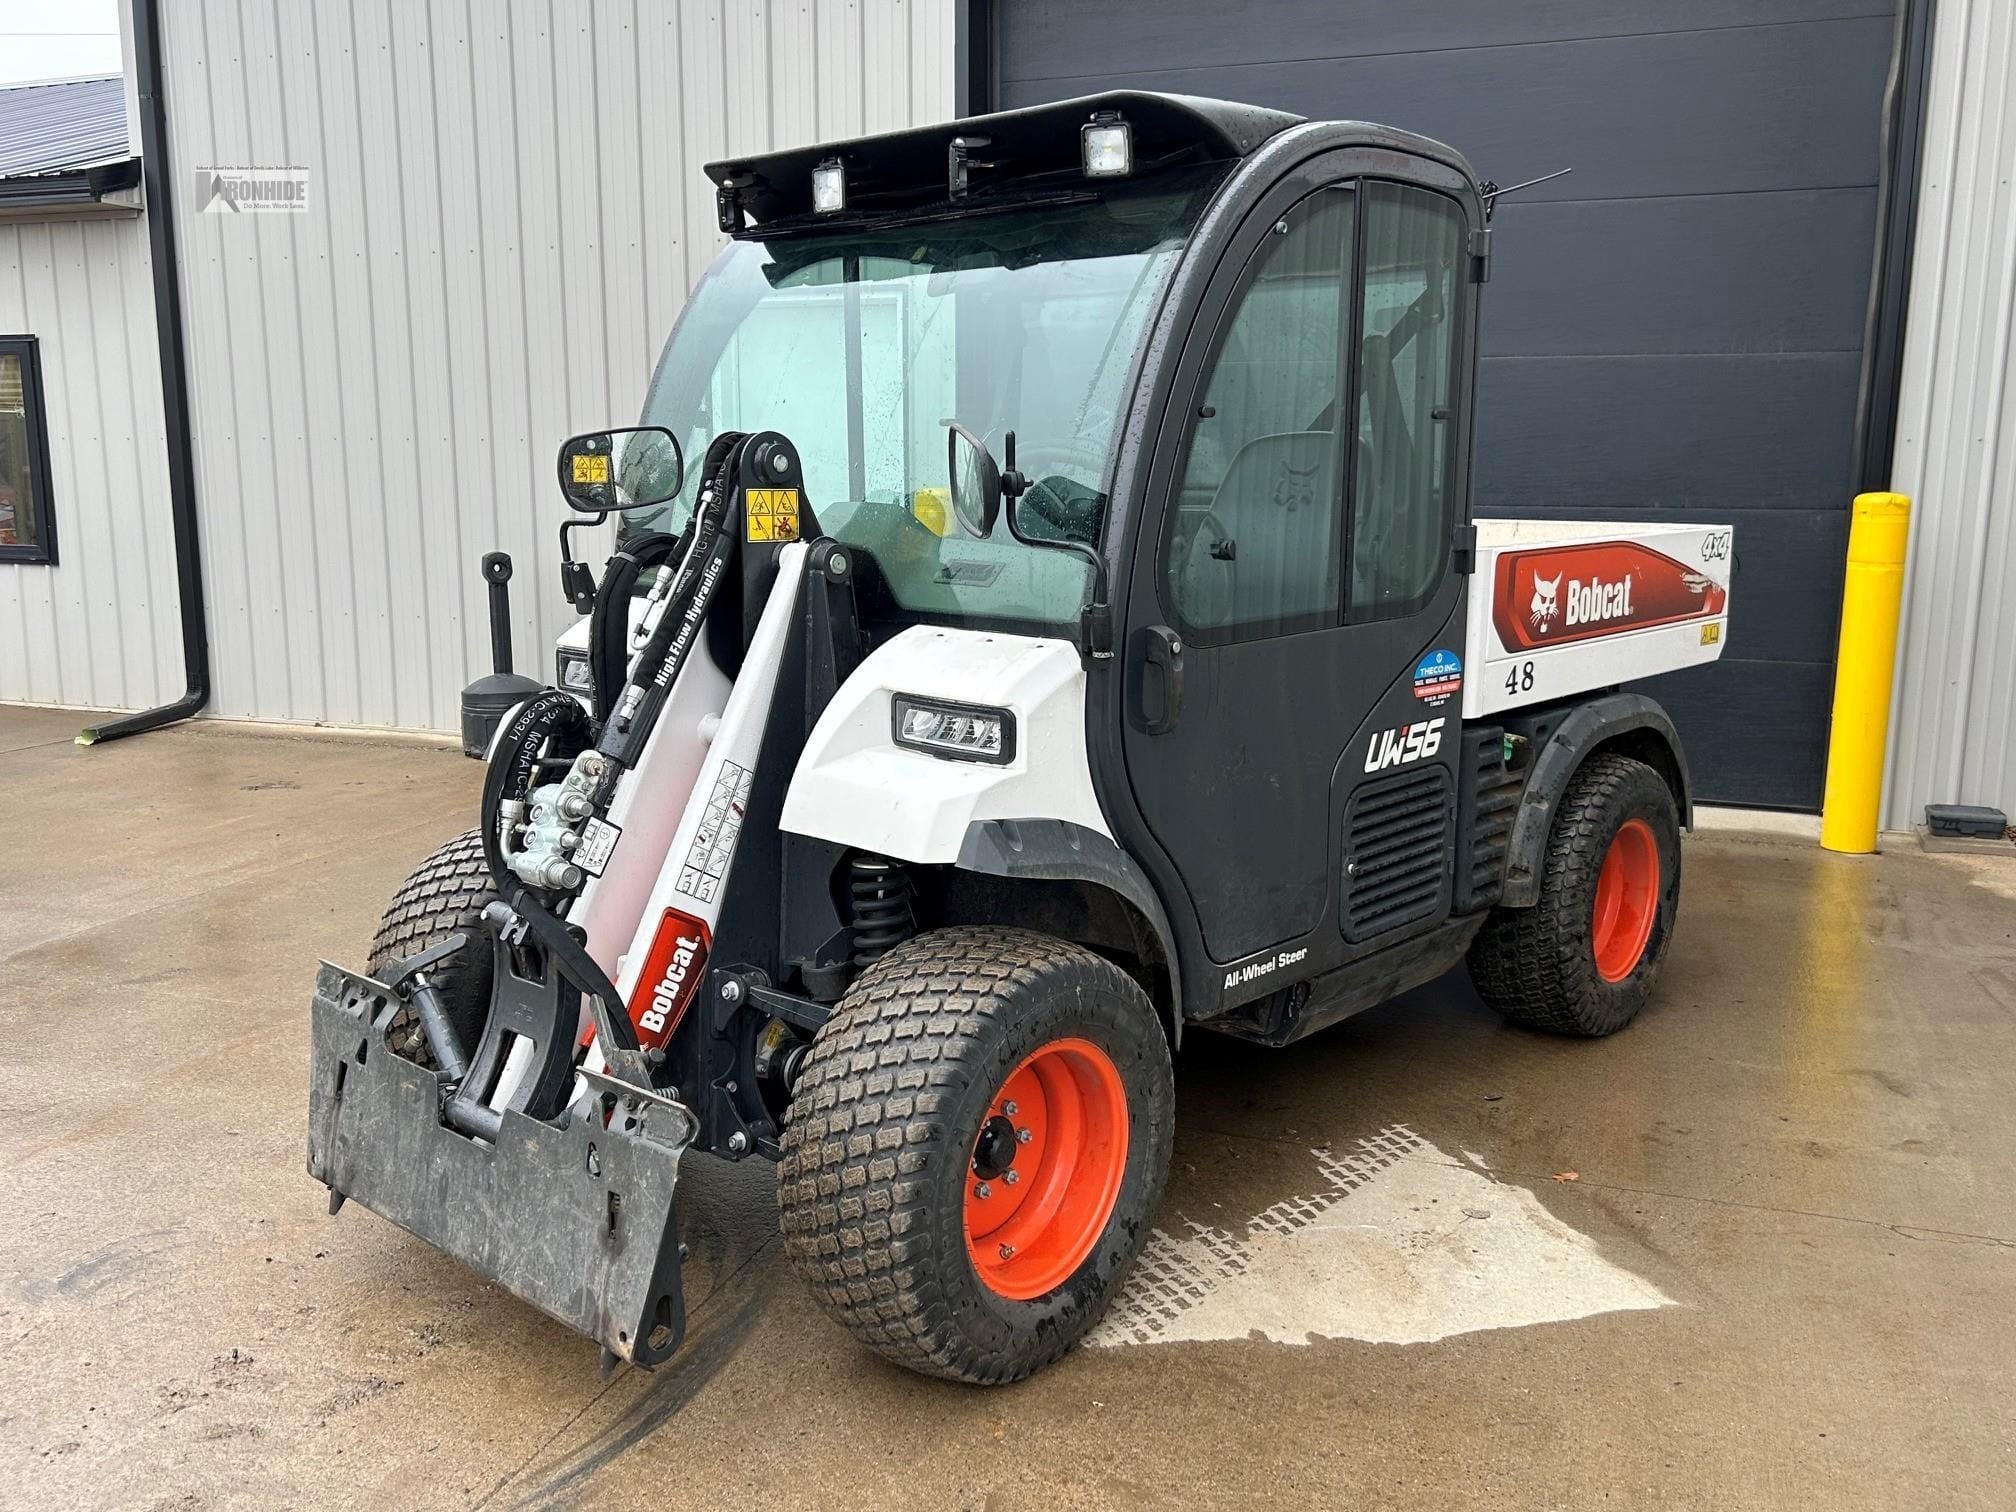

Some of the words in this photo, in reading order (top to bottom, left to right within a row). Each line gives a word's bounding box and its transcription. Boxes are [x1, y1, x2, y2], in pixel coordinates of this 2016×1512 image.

[1701, 531, 1731, 562] 4x4
[1565, 574, 1631, 626] Bobcat
[654, 656, 677, 687] High
[668, 622, 692, 657] Flow
[685, 556, 723, 623] Hydraulics
[1420, 666, 1444, 677] THECO
[1505, 661, 1535, 696] 48
[519, 731, 542, 768] MSHA
[639, 935, 698, 1034] Bobcat
[1224, 956, 1276, 990] All-Wheel
[1278, 947, 1308, 968] Steer
